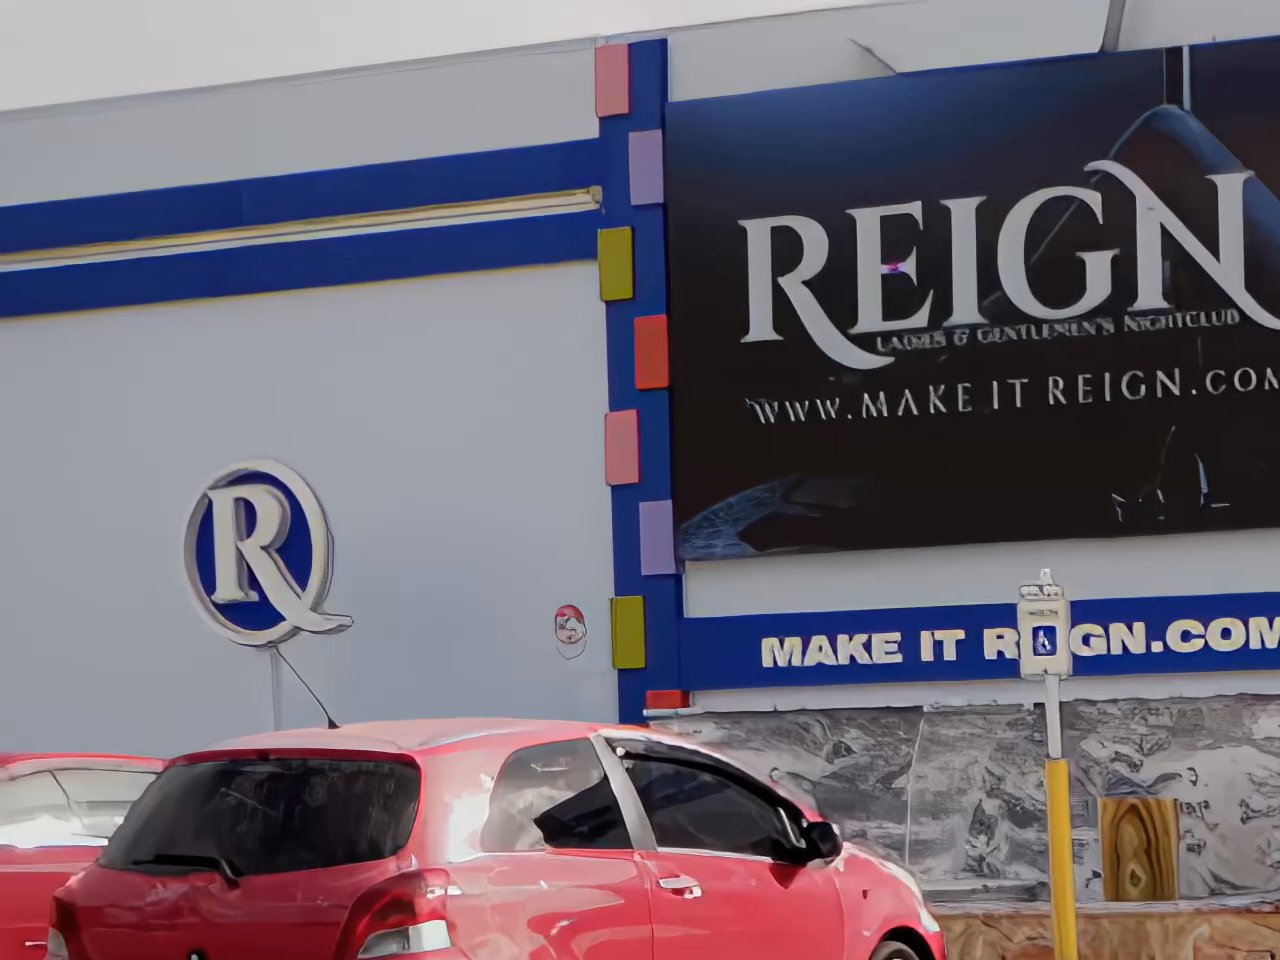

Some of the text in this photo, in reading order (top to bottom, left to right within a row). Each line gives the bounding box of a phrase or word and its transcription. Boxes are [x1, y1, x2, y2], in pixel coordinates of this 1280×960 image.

[992, 378, 1029, 409] IT
[761, 632, 903, 668] MAKE
[920, 629, 966, 662] IT
